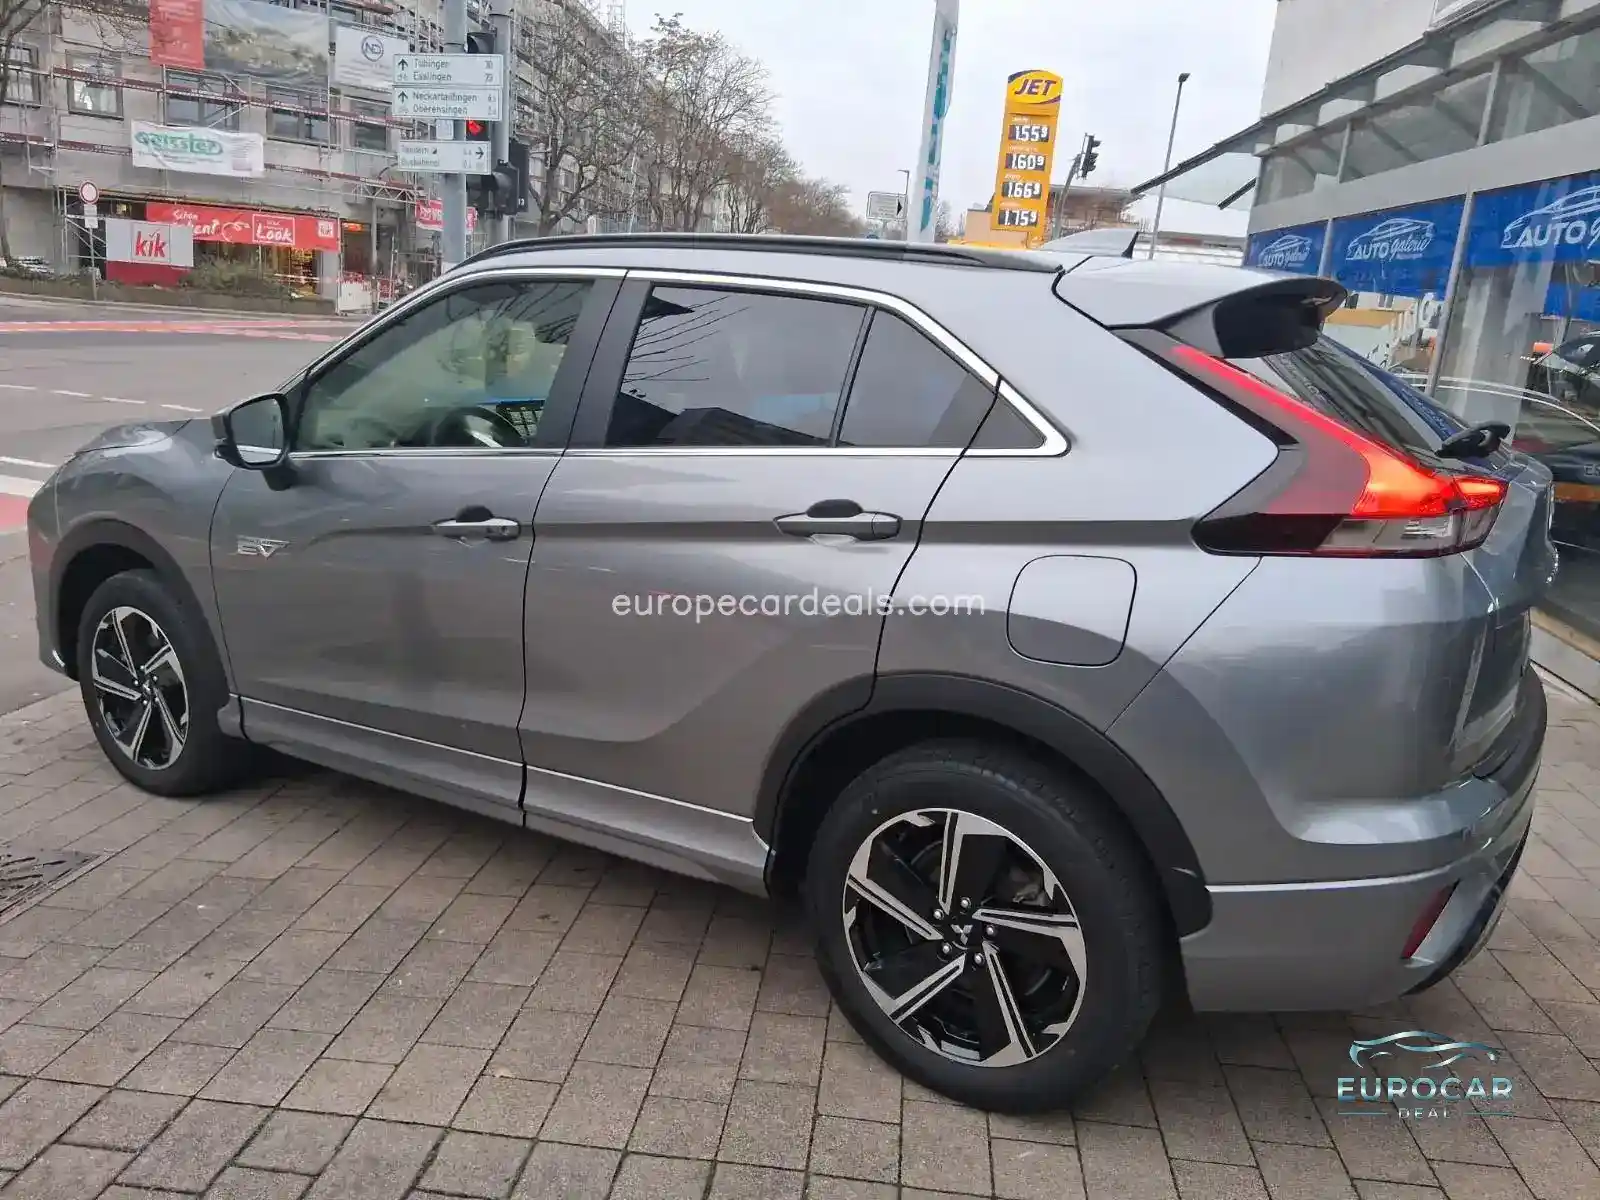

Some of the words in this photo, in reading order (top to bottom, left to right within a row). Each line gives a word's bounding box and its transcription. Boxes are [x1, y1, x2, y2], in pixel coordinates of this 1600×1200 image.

[1015, 79, 1057, 96] JET
[256, 223, 292, 242] Look
[1516, 220, 1587, 248] AUTO
[1353, 242, 1389, 259] AUTO
